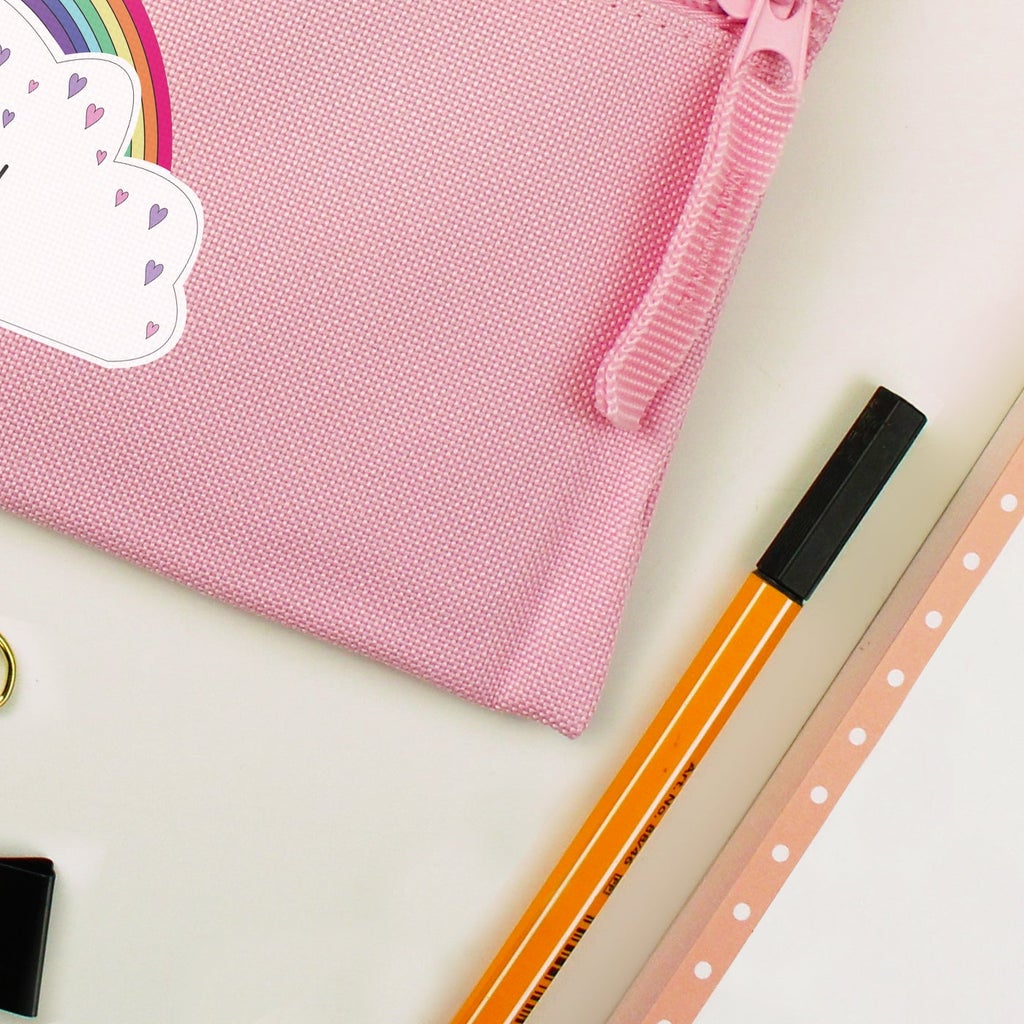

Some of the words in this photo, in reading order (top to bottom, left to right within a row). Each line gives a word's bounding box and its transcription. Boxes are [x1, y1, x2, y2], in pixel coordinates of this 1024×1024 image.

[673, 762, 696, 790] Art.
[654, 793, 676, 818] No.
[624, 823, 656, 865] 88/46
